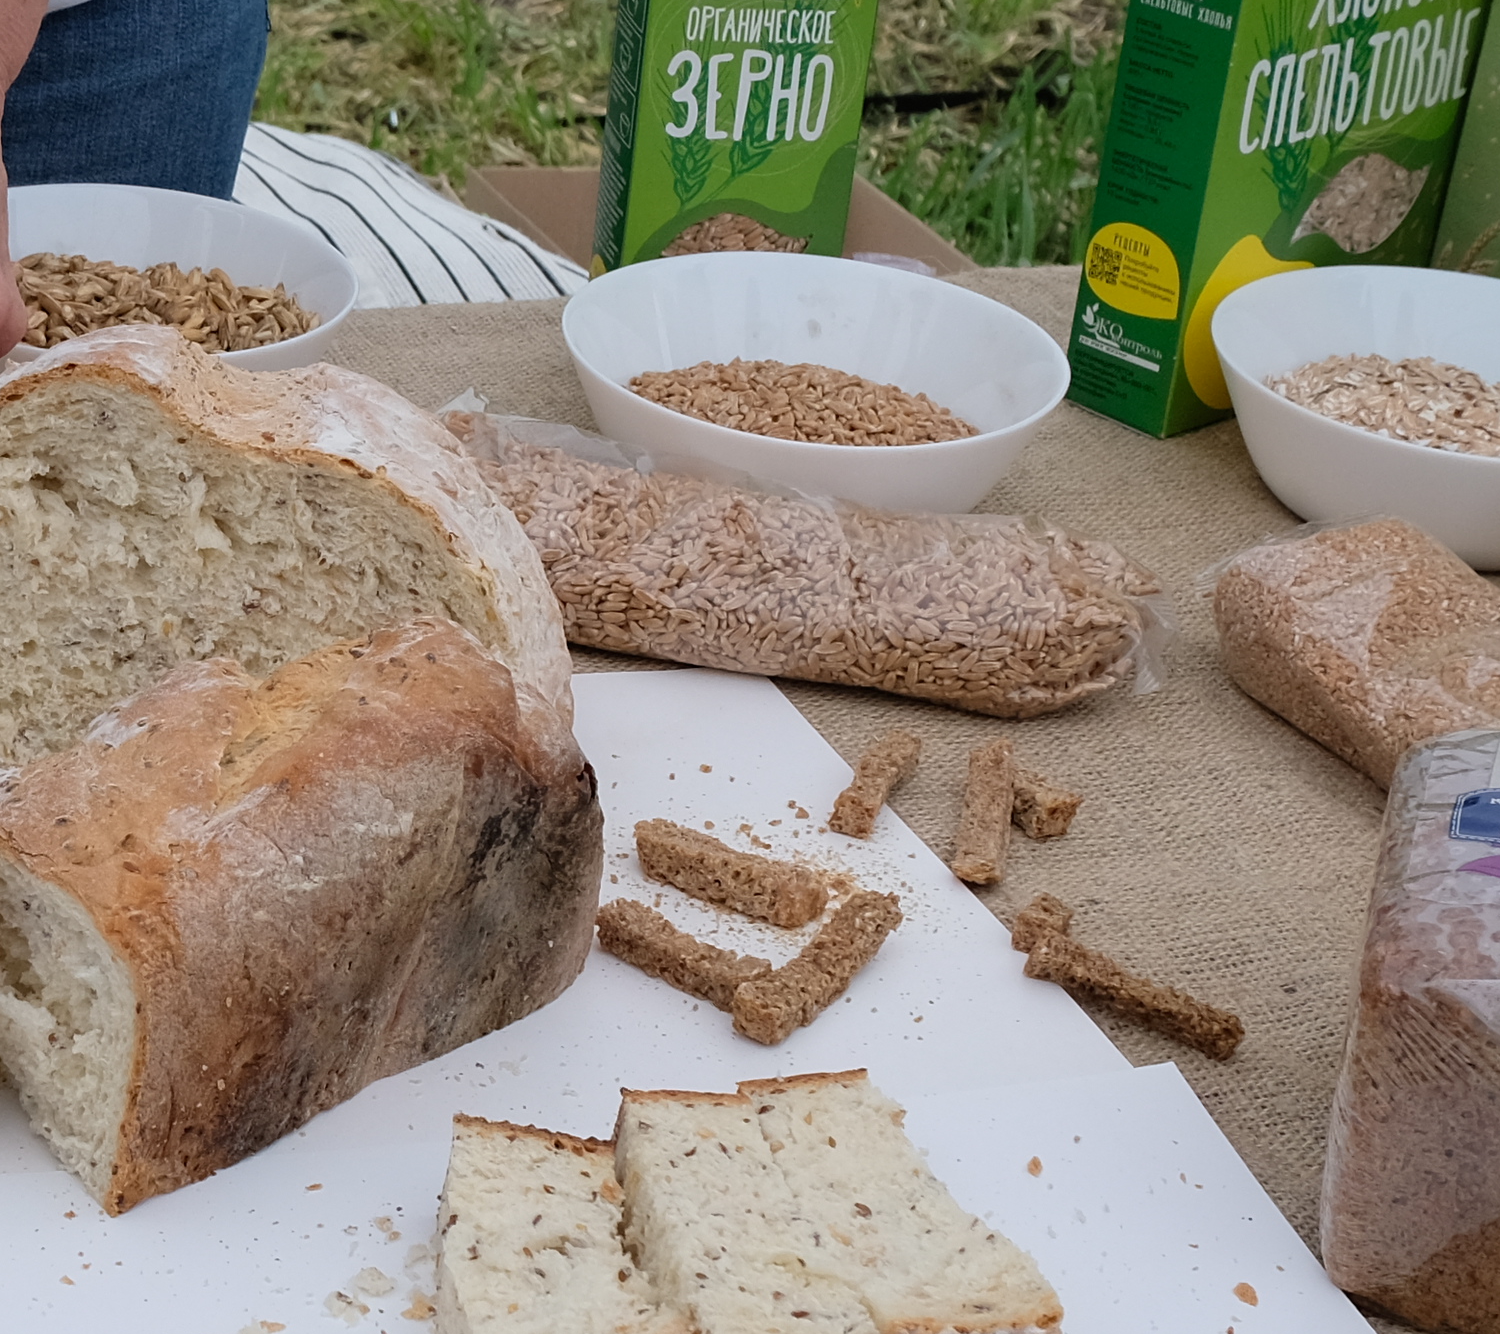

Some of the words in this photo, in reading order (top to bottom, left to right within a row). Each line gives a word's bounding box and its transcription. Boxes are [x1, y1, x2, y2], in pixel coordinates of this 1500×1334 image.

[686, 6, 837, 45] ОРГАНИЧЕСКОЕ
[1197, 7, 1234, 31] ХЛОПЬЯ
[665, 48, 835, 142] ЗЕРНО
[1238, 6, 1482, 155] СПЕЛЬТОВЫЕ
[1113, 232, 1151, 257] РЕЦЕПТЫ
